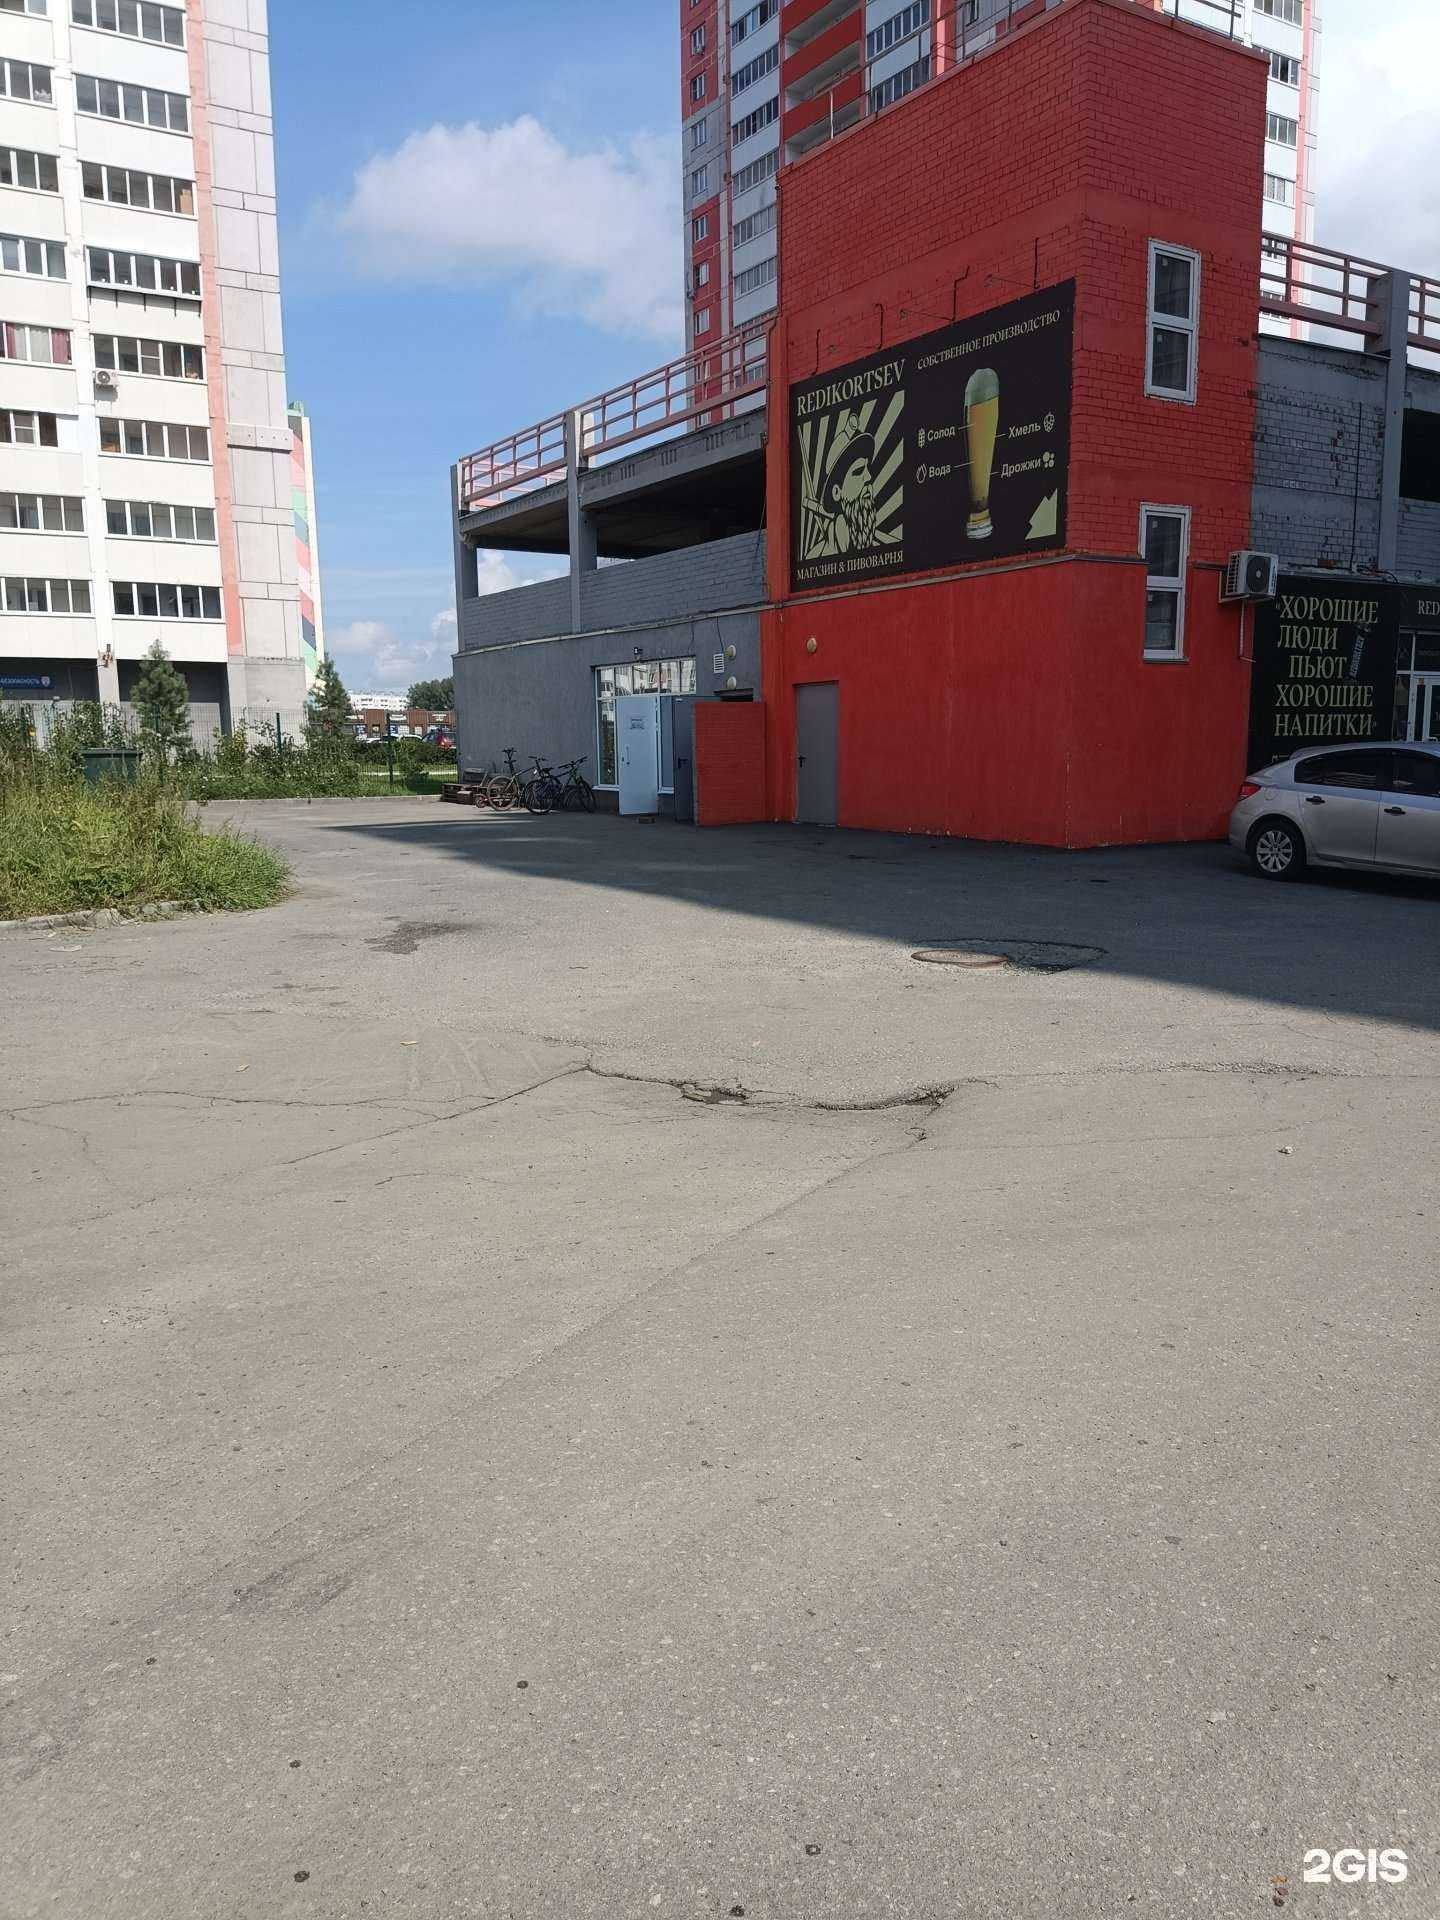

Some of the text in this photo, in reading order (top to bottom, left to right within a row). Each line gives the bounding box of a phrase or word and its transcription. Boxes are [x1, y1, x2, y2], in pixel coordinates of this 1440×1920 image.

[917, 310, 1061, 371] СОБСТВЕННОЕ ПРОИЗВОДСТВО
[796, 358, 906, 417] REDIKORTSEV
[927, 426, 956, 442] Солод
[1007, 422, 1042, 440] Хмель
[928, 463, 951, 478] Вода
[1001, 458, 1042, 479] Дрожжи
[796, 550, 904, 581] МАГАЗИН & ПИВОВАРНЯ
[1277, 625, 1338, 654] ЛЮДИ
[1288, 656, 1348, 679] ПЬЮТ
[1275, 684, 1374, 708] ХОРОШИЕ
